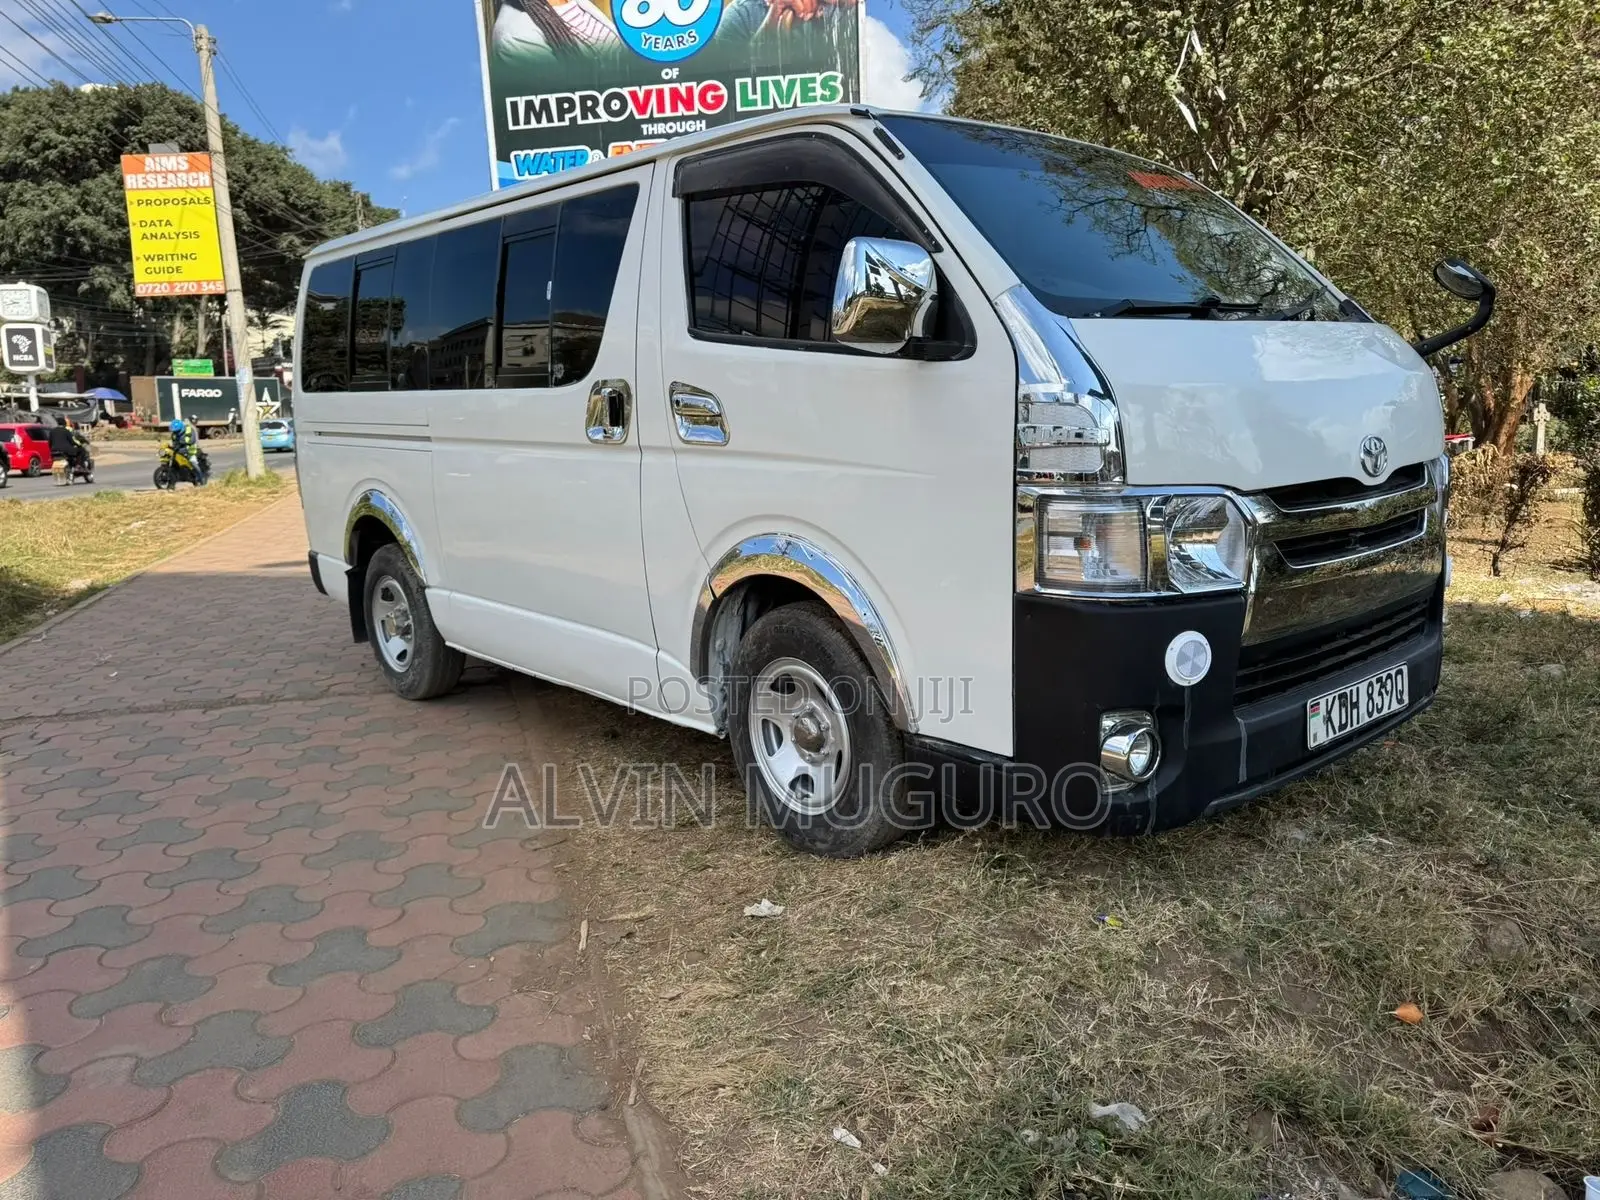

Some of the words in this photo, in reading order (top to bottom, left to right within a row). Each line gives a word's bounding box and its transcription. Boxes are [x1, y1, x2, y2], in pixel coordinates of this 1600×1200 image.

[641, 30, 698, 50] YEARS
[661, 68, 679, 79] OF
[507, 81, 727, 130] IMPROVING
[736, 73, 843, 111] LIVES
[641, 120, 706, 135] THROUGH
[144, 155, 188, 171] AIMS
[126, 171, 210, 189] RESEARCH
[137, 196, 211, 207] PROPOSALS
[139, 219, 173, 228] DATA
[140, 231, 200, 241] ANALYSIS
[143, 252, 198, 262] WRITING
[144, 266, 183, 275] GUIDE
[137, 283, 170, 294] 0720
[173, 282, 198, 293] 270
[201, 280, 223, 292] 345
[181, 388, 222, 398] FARGO
[1325, 686, 1360, 738] KDH
[1366, 667, 1405, 719] 839Q
